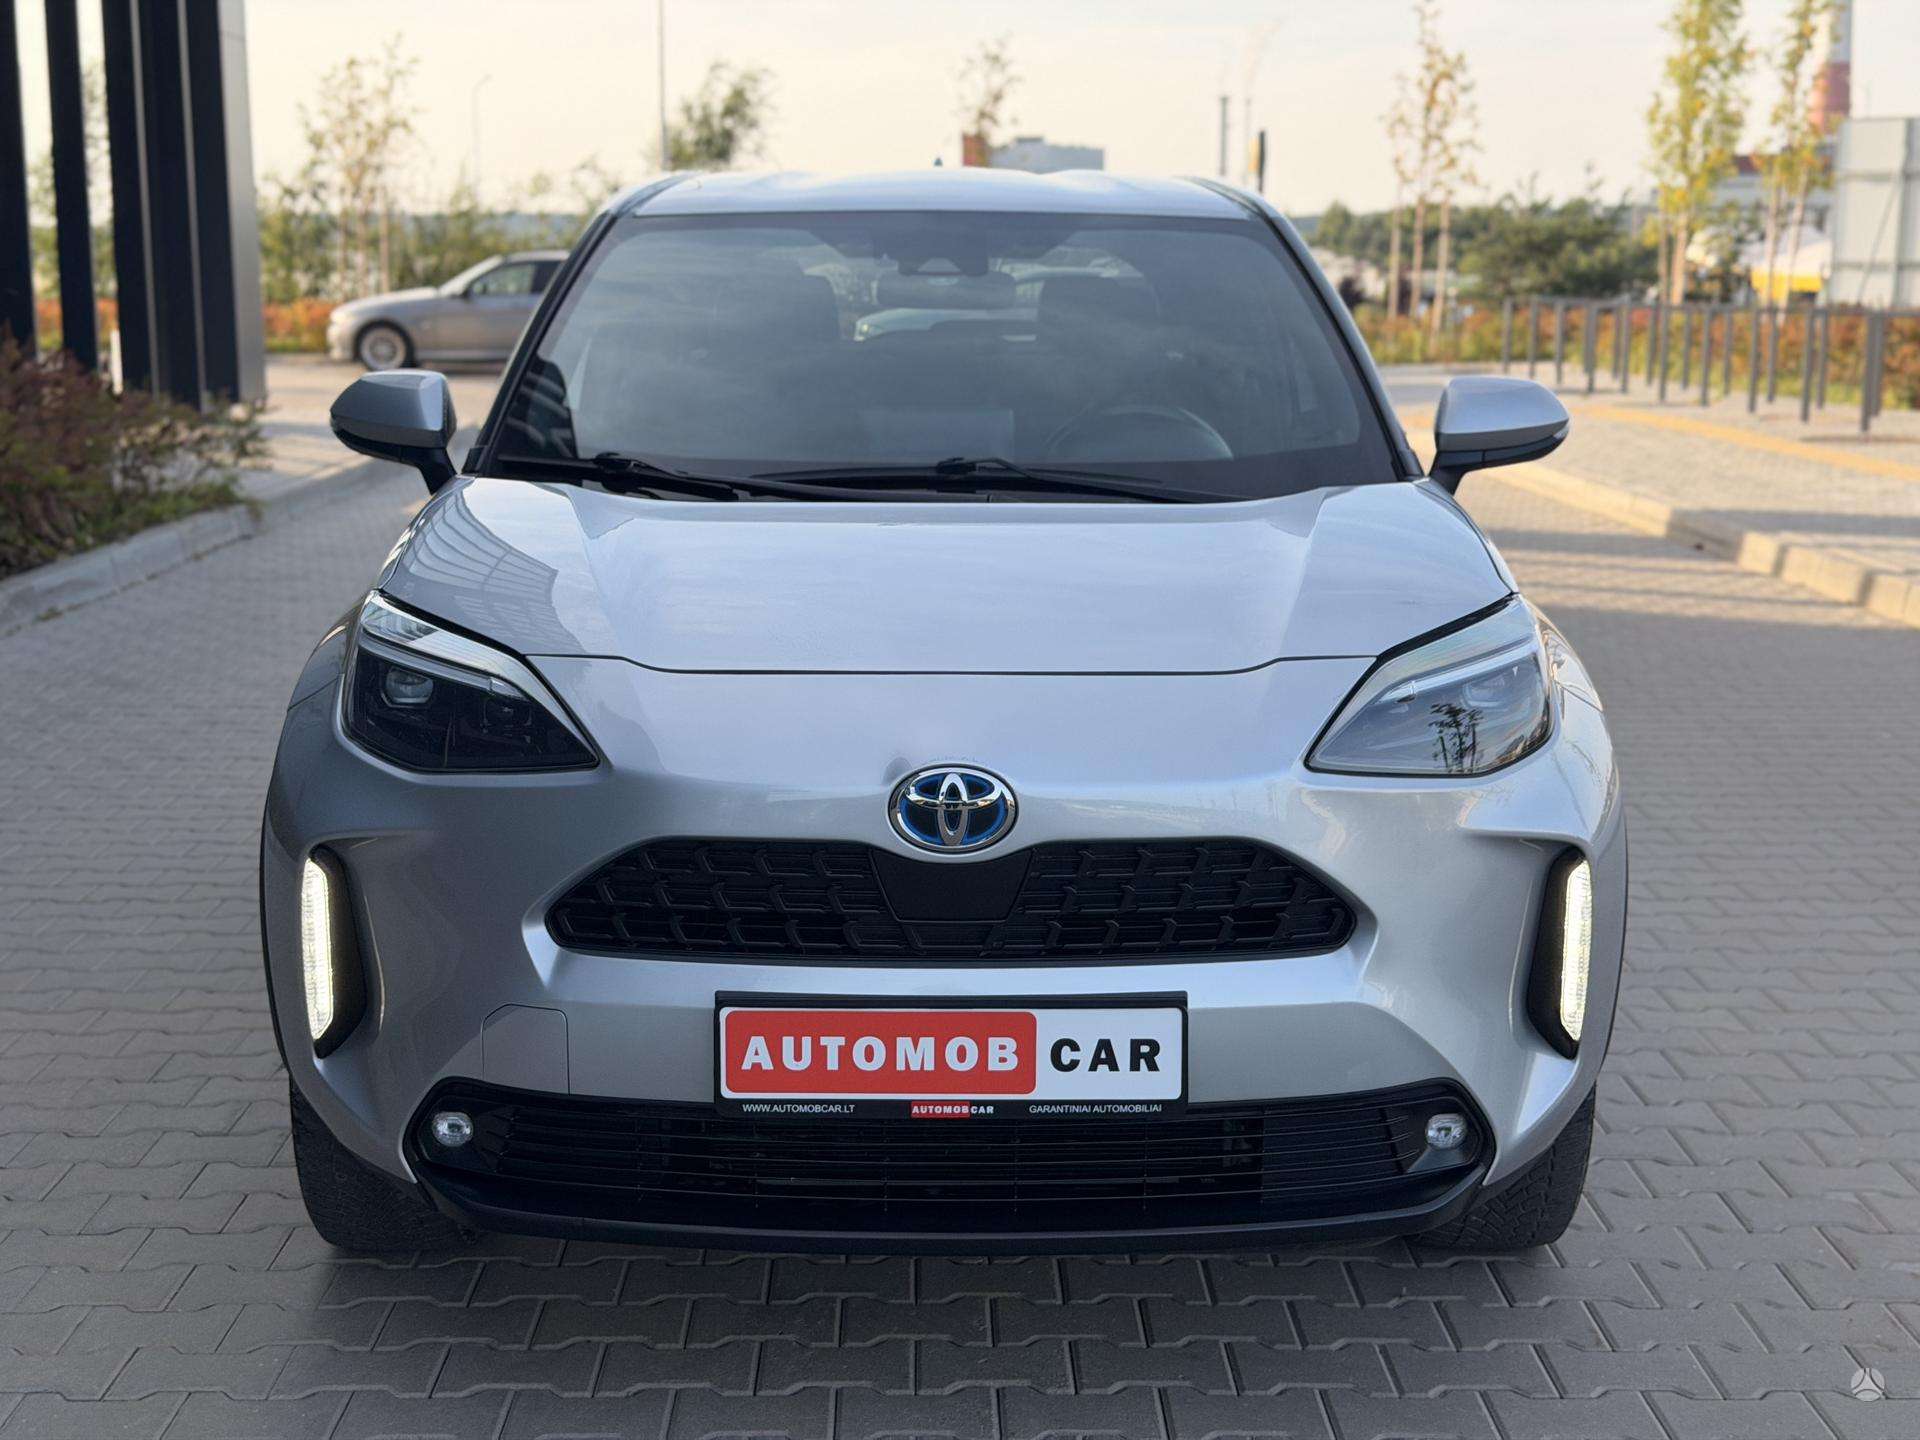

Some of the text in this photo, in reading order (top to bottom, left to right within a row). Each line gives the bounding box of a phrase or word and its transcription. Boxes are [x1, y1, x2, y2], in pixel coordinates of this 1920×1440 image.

[741, 1035, 1161, 1072] AUTOMOB CAR
[742, 1103, 855, 1114] WWW.AUTOMOBCAR.LT
[1029, 1104, 1162, 1114] GARANTINIAI AUTOMOBILIAI
